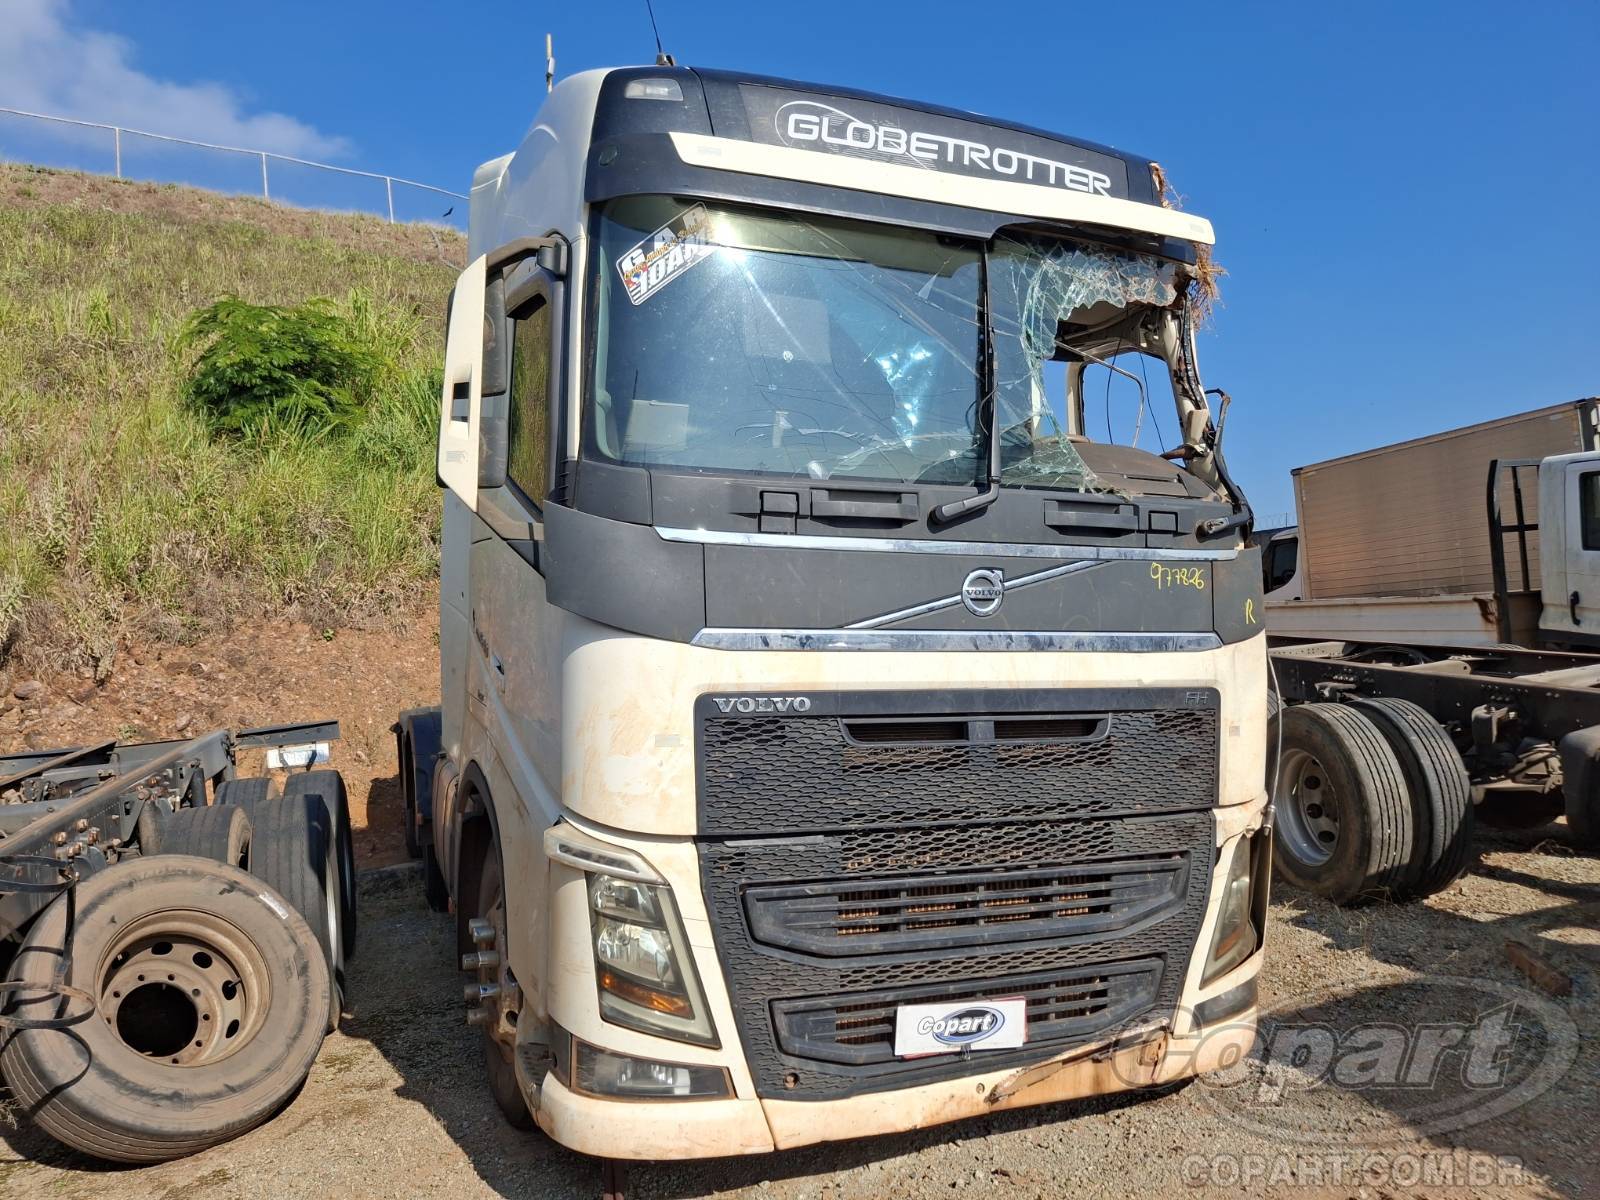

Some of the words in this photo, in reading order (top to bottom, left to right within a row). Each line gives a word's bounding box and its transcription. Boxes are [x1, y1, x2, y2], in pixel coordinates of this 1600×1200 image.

[788, 113, 1112, 198] GLOBETROTTER
[1245, 598, 1256, 624] R
[712, 696, 812, 713] VOLVO
[917, 1012, 995, 1038] Copart
